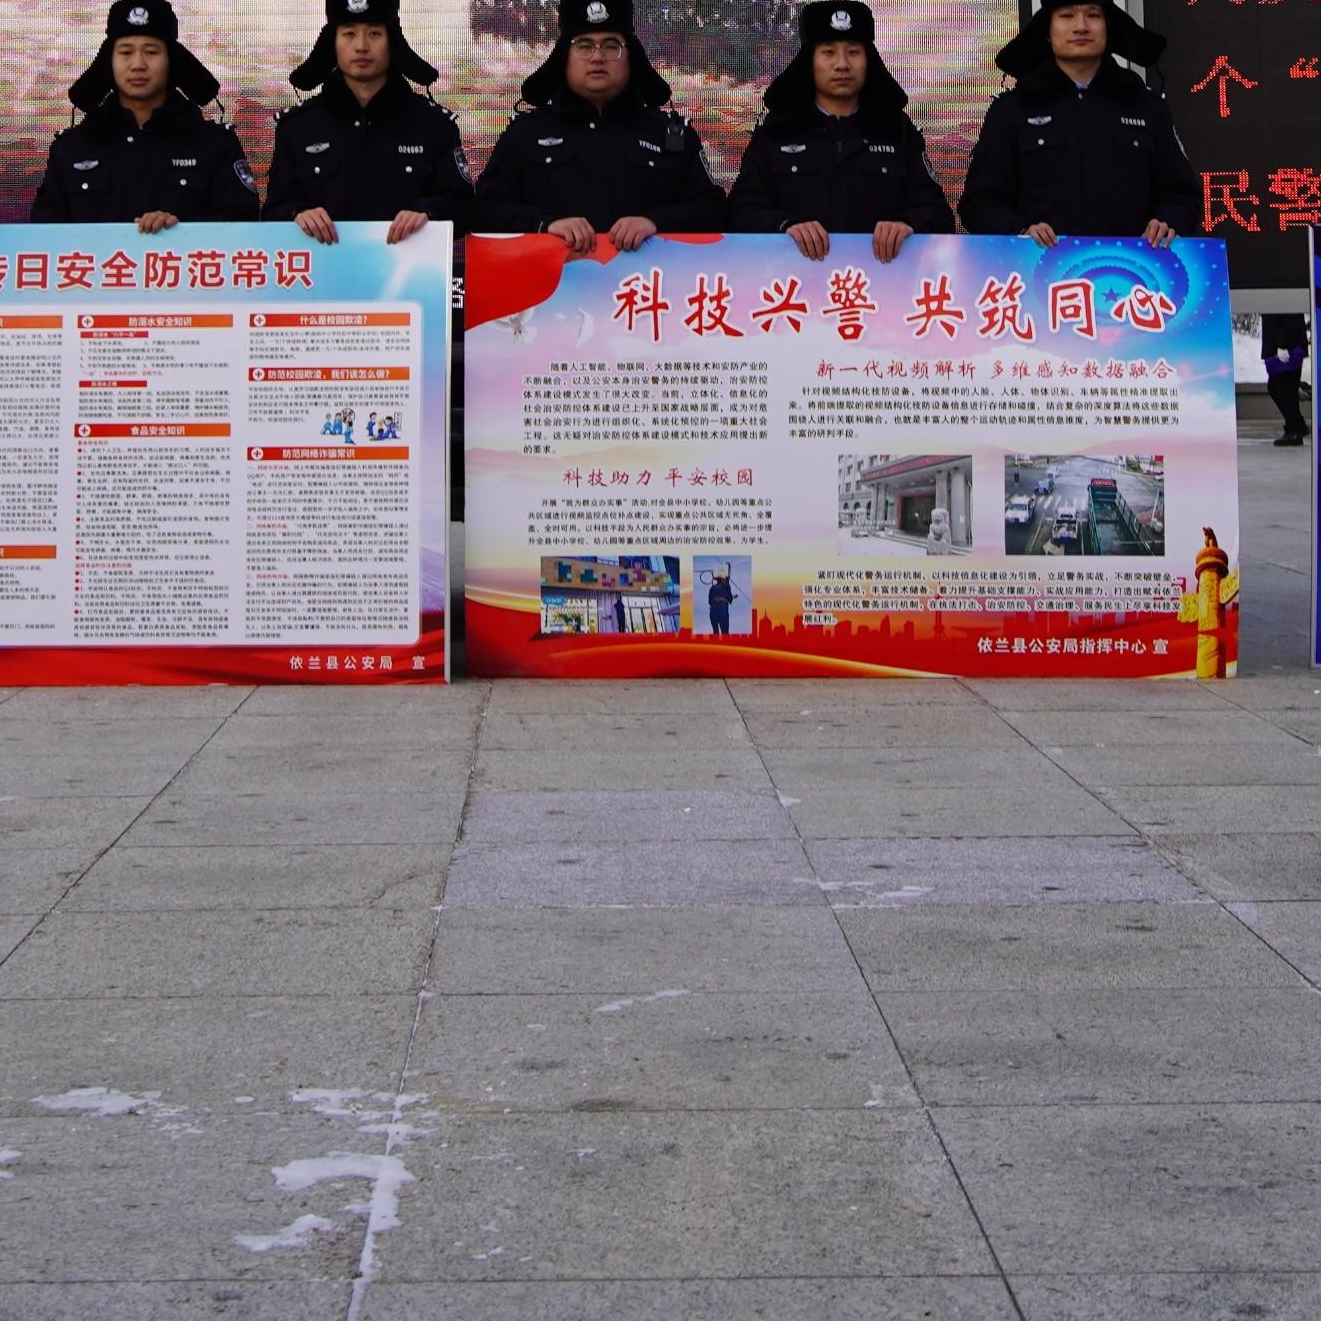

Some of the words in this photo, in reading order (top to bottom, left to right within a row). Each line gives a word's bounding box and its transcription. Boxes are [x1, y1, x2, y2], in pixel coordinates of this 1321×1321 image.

[612, 265, 877, 343] 科技兴警
[905, 270, 1178, 343] 共筑同心
[128, 316, 192, 327] 防溺水安全知识
[816, 359, 977, 380] 新一代视频解析
[990, 358, 1174, 380] 多维感知数据融合
[130, 425, 186, 436] 食品安全知识
[788, 429, 859, 439] 丰富的研判手段。
[523, 445, 557, 454] 的要求。
[562, 467, 652, 488] 科技助力
[665, 467, 753, 488] 平安校园
[977, 638, 1146, 654] 依兰县公安局指挥中心
[1153, 638, 1169, 654] 宣
[290, 655, 393, 670] 依兰县公安局
[412, 655, 426, 670] 宣
